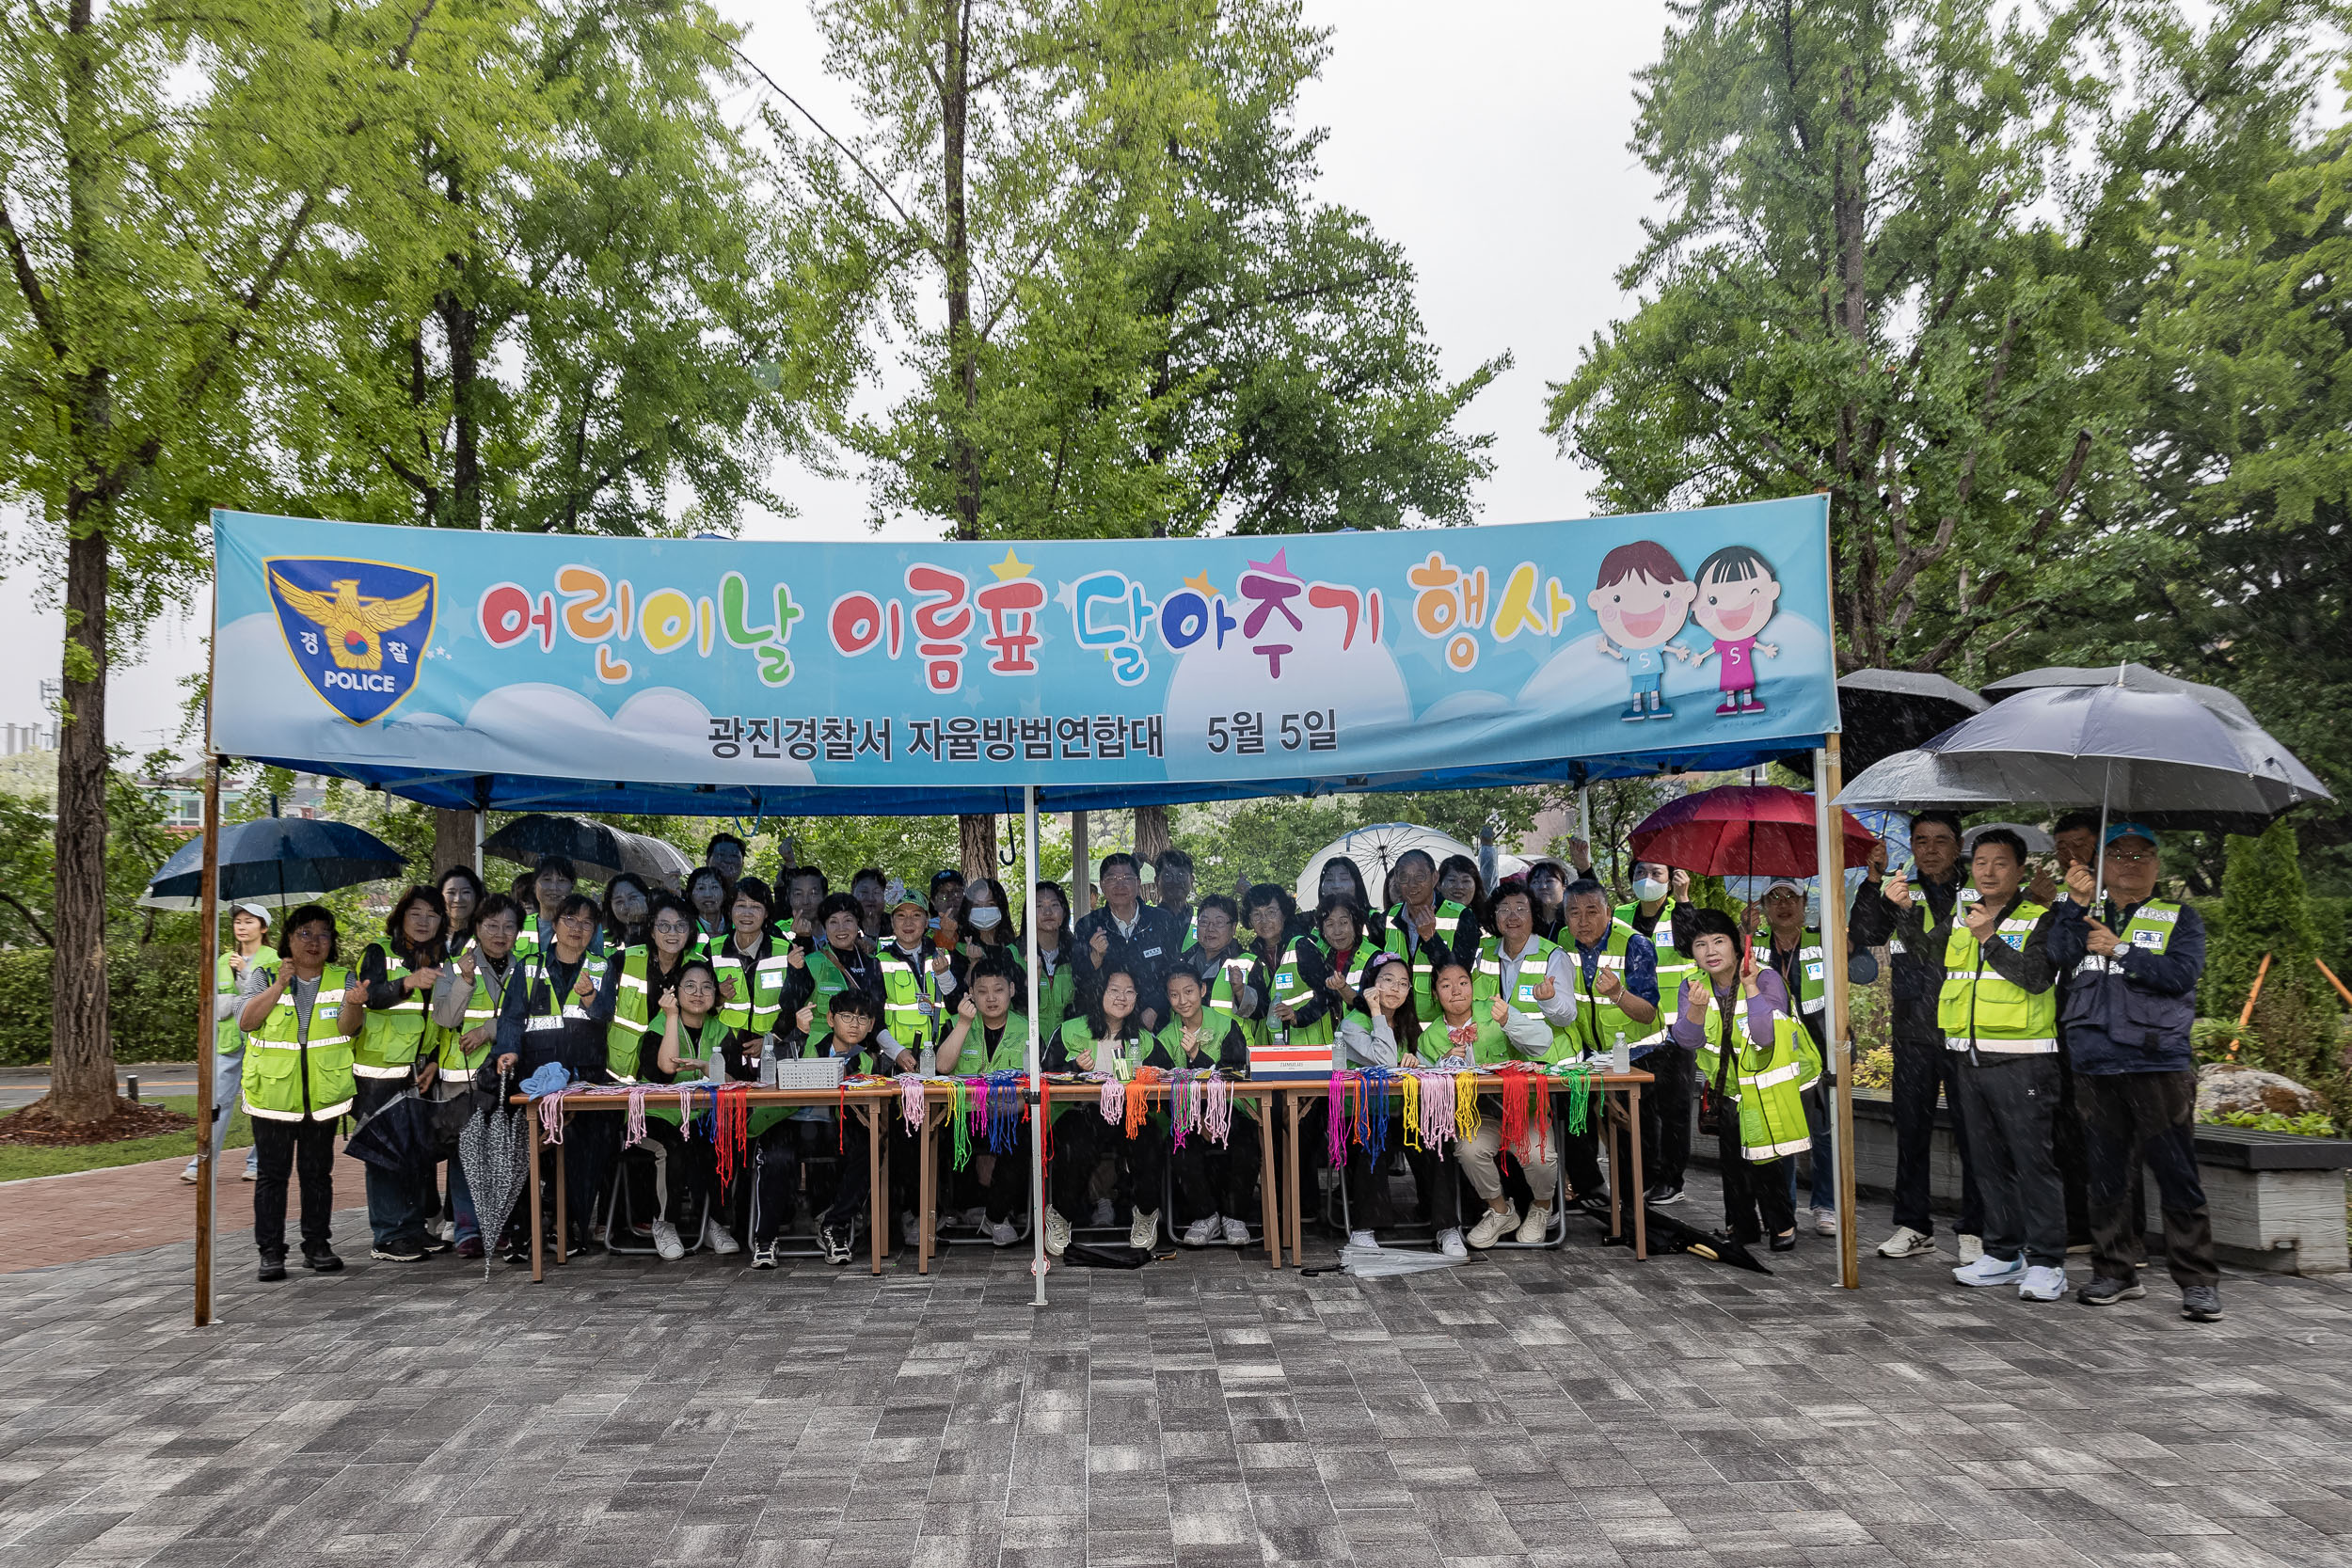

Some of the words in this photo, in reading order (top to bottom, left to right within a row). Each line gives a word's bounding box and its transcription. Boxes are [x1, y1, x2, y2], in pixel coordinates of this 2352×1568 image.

[479, 565, 803, 686] 어린이날
[829, 563, 1046, 693] 이름표
[1073, 570, 1383, 685] 달아주기
[1407, 552, 1575, 672] 행사
[300, 631, 319, 656] 경
[387, 641, 409, 664] 찰
[1639, 652, 1650, 669] S
[1729, 646, 1741, 665] S
[324, 670, 395, 693] POLICE
[708, 715, 893, 763] 광진경찰서
[907, 714, 1165, 763] 자율방범연합대
[1207, 711, 1265, 755] 5월
[1279, 708, 1338, 752] 5일
